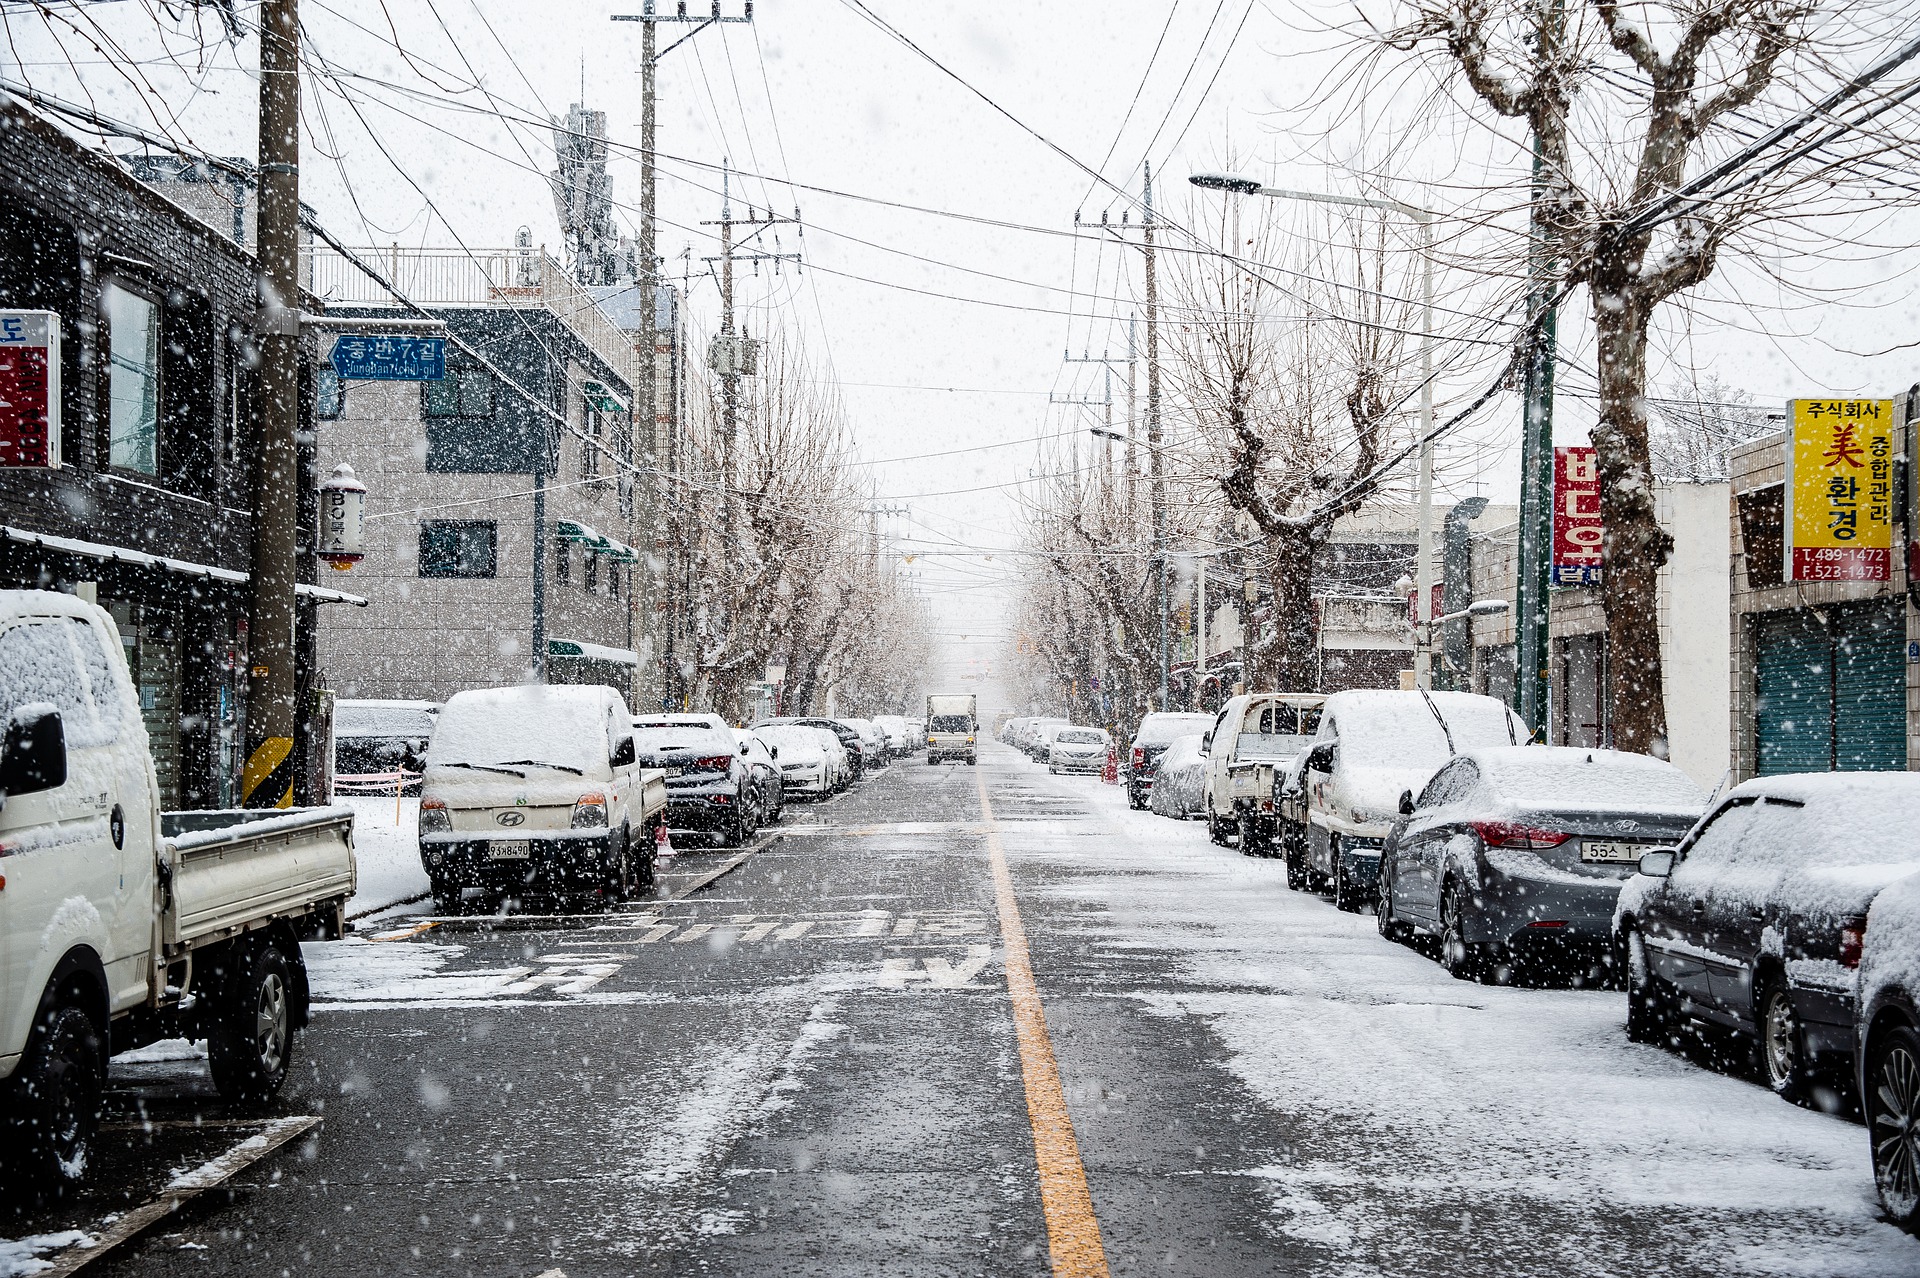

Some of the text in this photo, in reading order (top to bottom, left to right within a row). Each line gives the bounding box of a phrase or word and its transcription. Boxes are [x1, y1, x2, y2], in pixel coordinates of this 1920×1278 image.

[1807, 402, 1881, 419] 주식회사
[1822, 423, 1865, 468] 美
[1869, 436, 1890, 526] 종합관리
[1826, 476, 1860, 541] 환경
[1802, 548, 1884, 562] T.489-1472
[1802, 565, 1883, 578] F.523-1473
